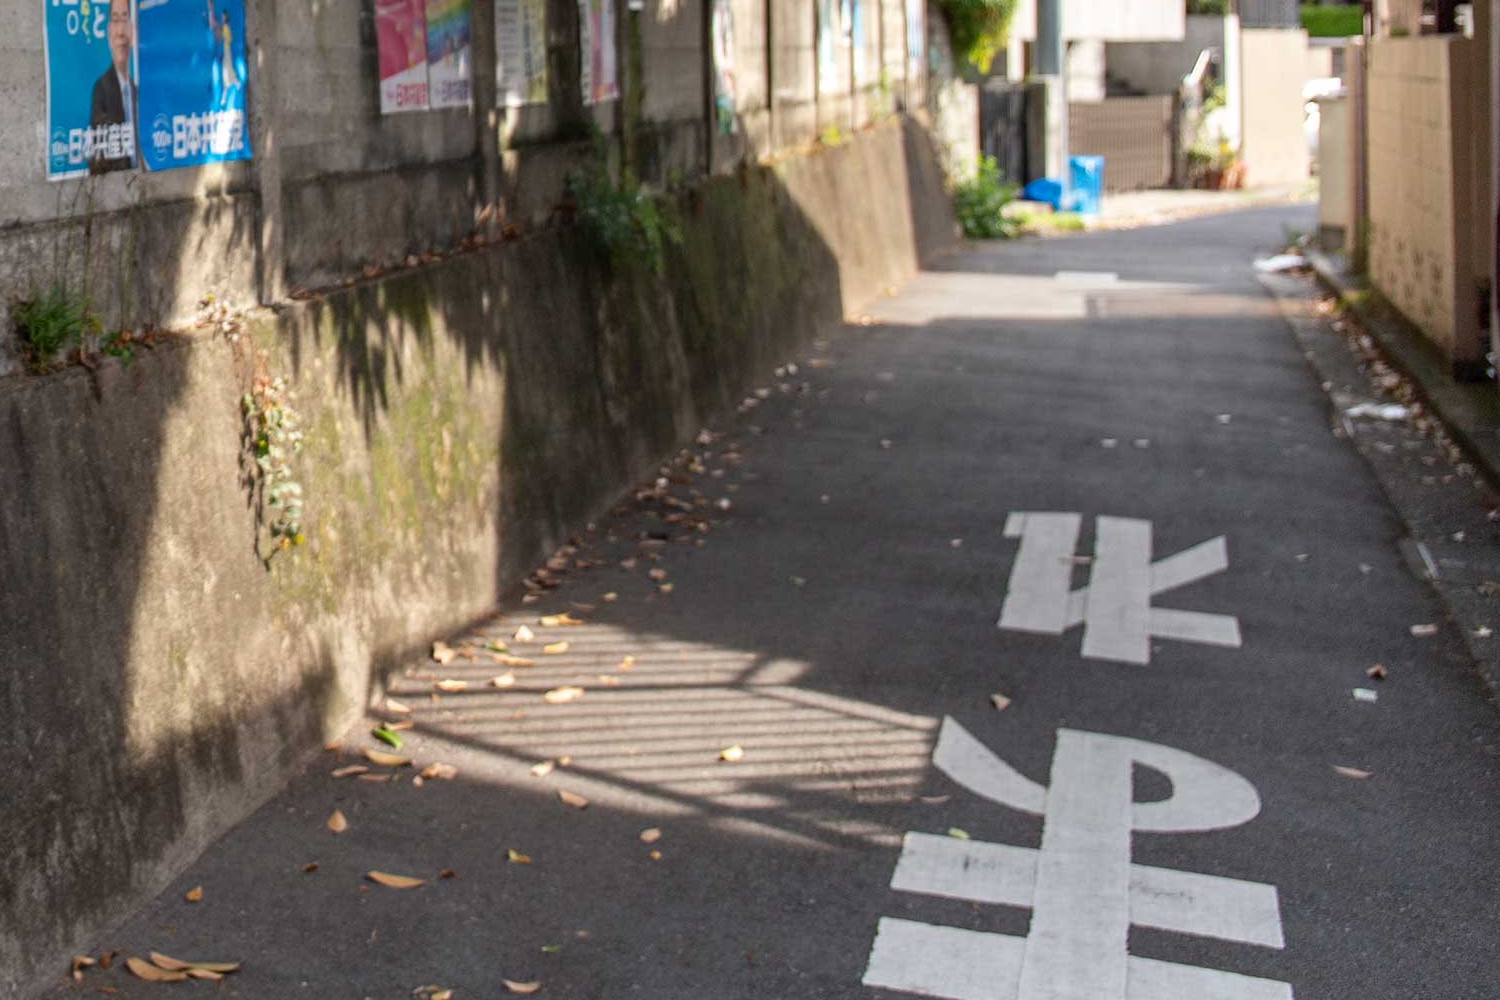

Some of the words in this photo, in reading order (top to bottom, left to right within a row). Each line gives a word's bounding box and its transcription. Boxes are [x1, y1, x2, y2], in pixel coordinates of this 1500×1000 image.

[68, 122, 135, 166] 日本共産党
